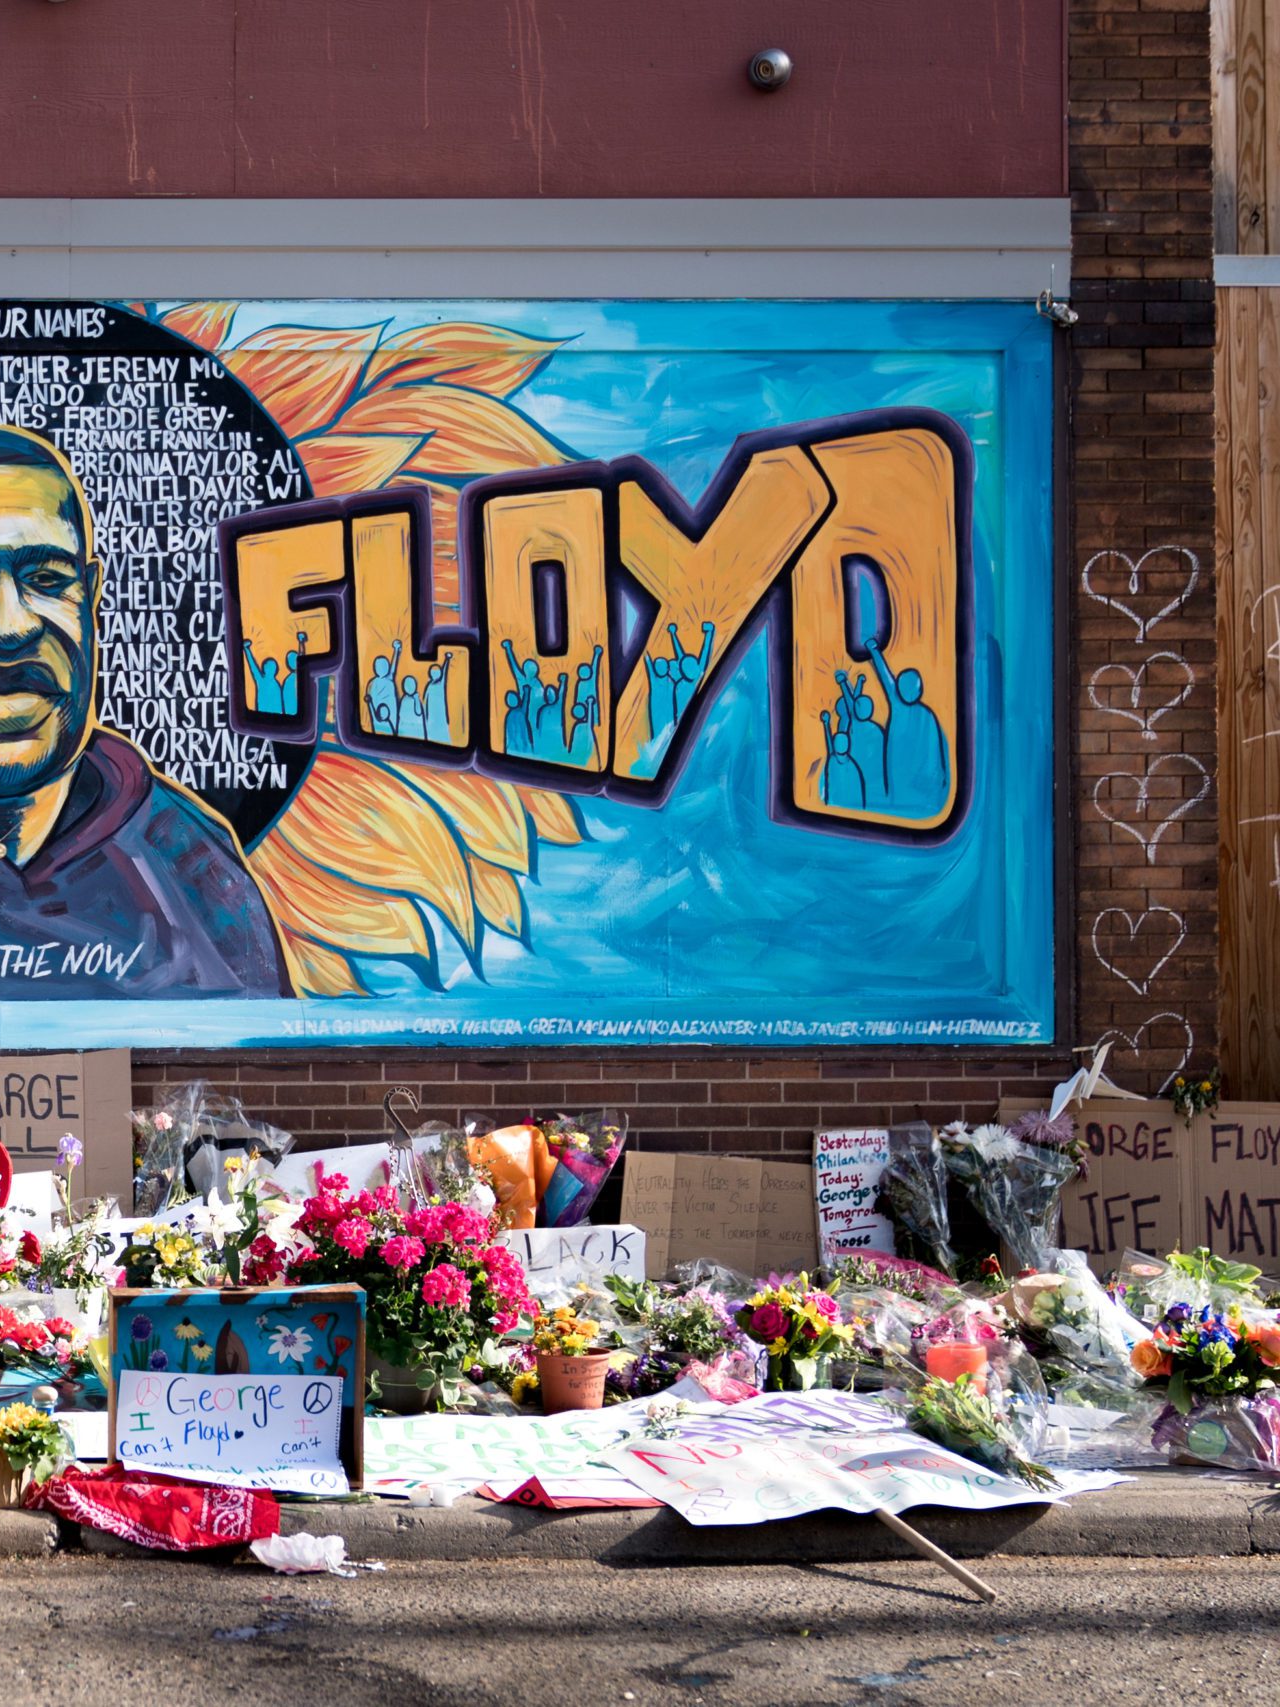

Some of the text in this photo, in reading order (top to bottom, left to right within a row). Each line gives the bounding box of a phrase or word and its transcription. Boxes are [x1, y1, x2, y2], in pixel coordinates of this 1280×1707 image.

[34, 308, 106, 339] NAMES
[79, 357, 180, 385] JEREMY
[107, 382, 199, 407] CASTILE
[65, 406, 159, 431] FREDDIE
[165, 405, 228, 431] GREY
[49, 428, 251, 451] TERRANCE FRANKLIN
[70, 452, 173, 477] BREONNA
[170, 451, 260, 477] TAYLOR
[82, 475, 187, 502] SHANTEL
[189, 475, 256, 501] DAVIS
[88, 500, 185, 527] WALTER
[93, 526, 164, 554] REKIA
[100, 580, 186, 611] SHELLY
[95, 611, 183, 645] JAMAR
[235, 426, 961, 832] FLOYD
[98, 642, 204, 673] TANISHA
[98, 671, 189, 699] TARIKA
[99, 698, 178, 730] ALTON
[129, 728, 276, 764] KORRYNGA
[164, 761, 288, 791] KATHRYN
[61, 941, 146, 982] NOW
[528, 1018, 573, 1035] GRETA
[819, 1171, 864, 1190] Today:
[820, 1185, 872, 1207] George
[1058, 1190, 1162, 1257] LIFE
[166, 1376, 285, 1429] George
